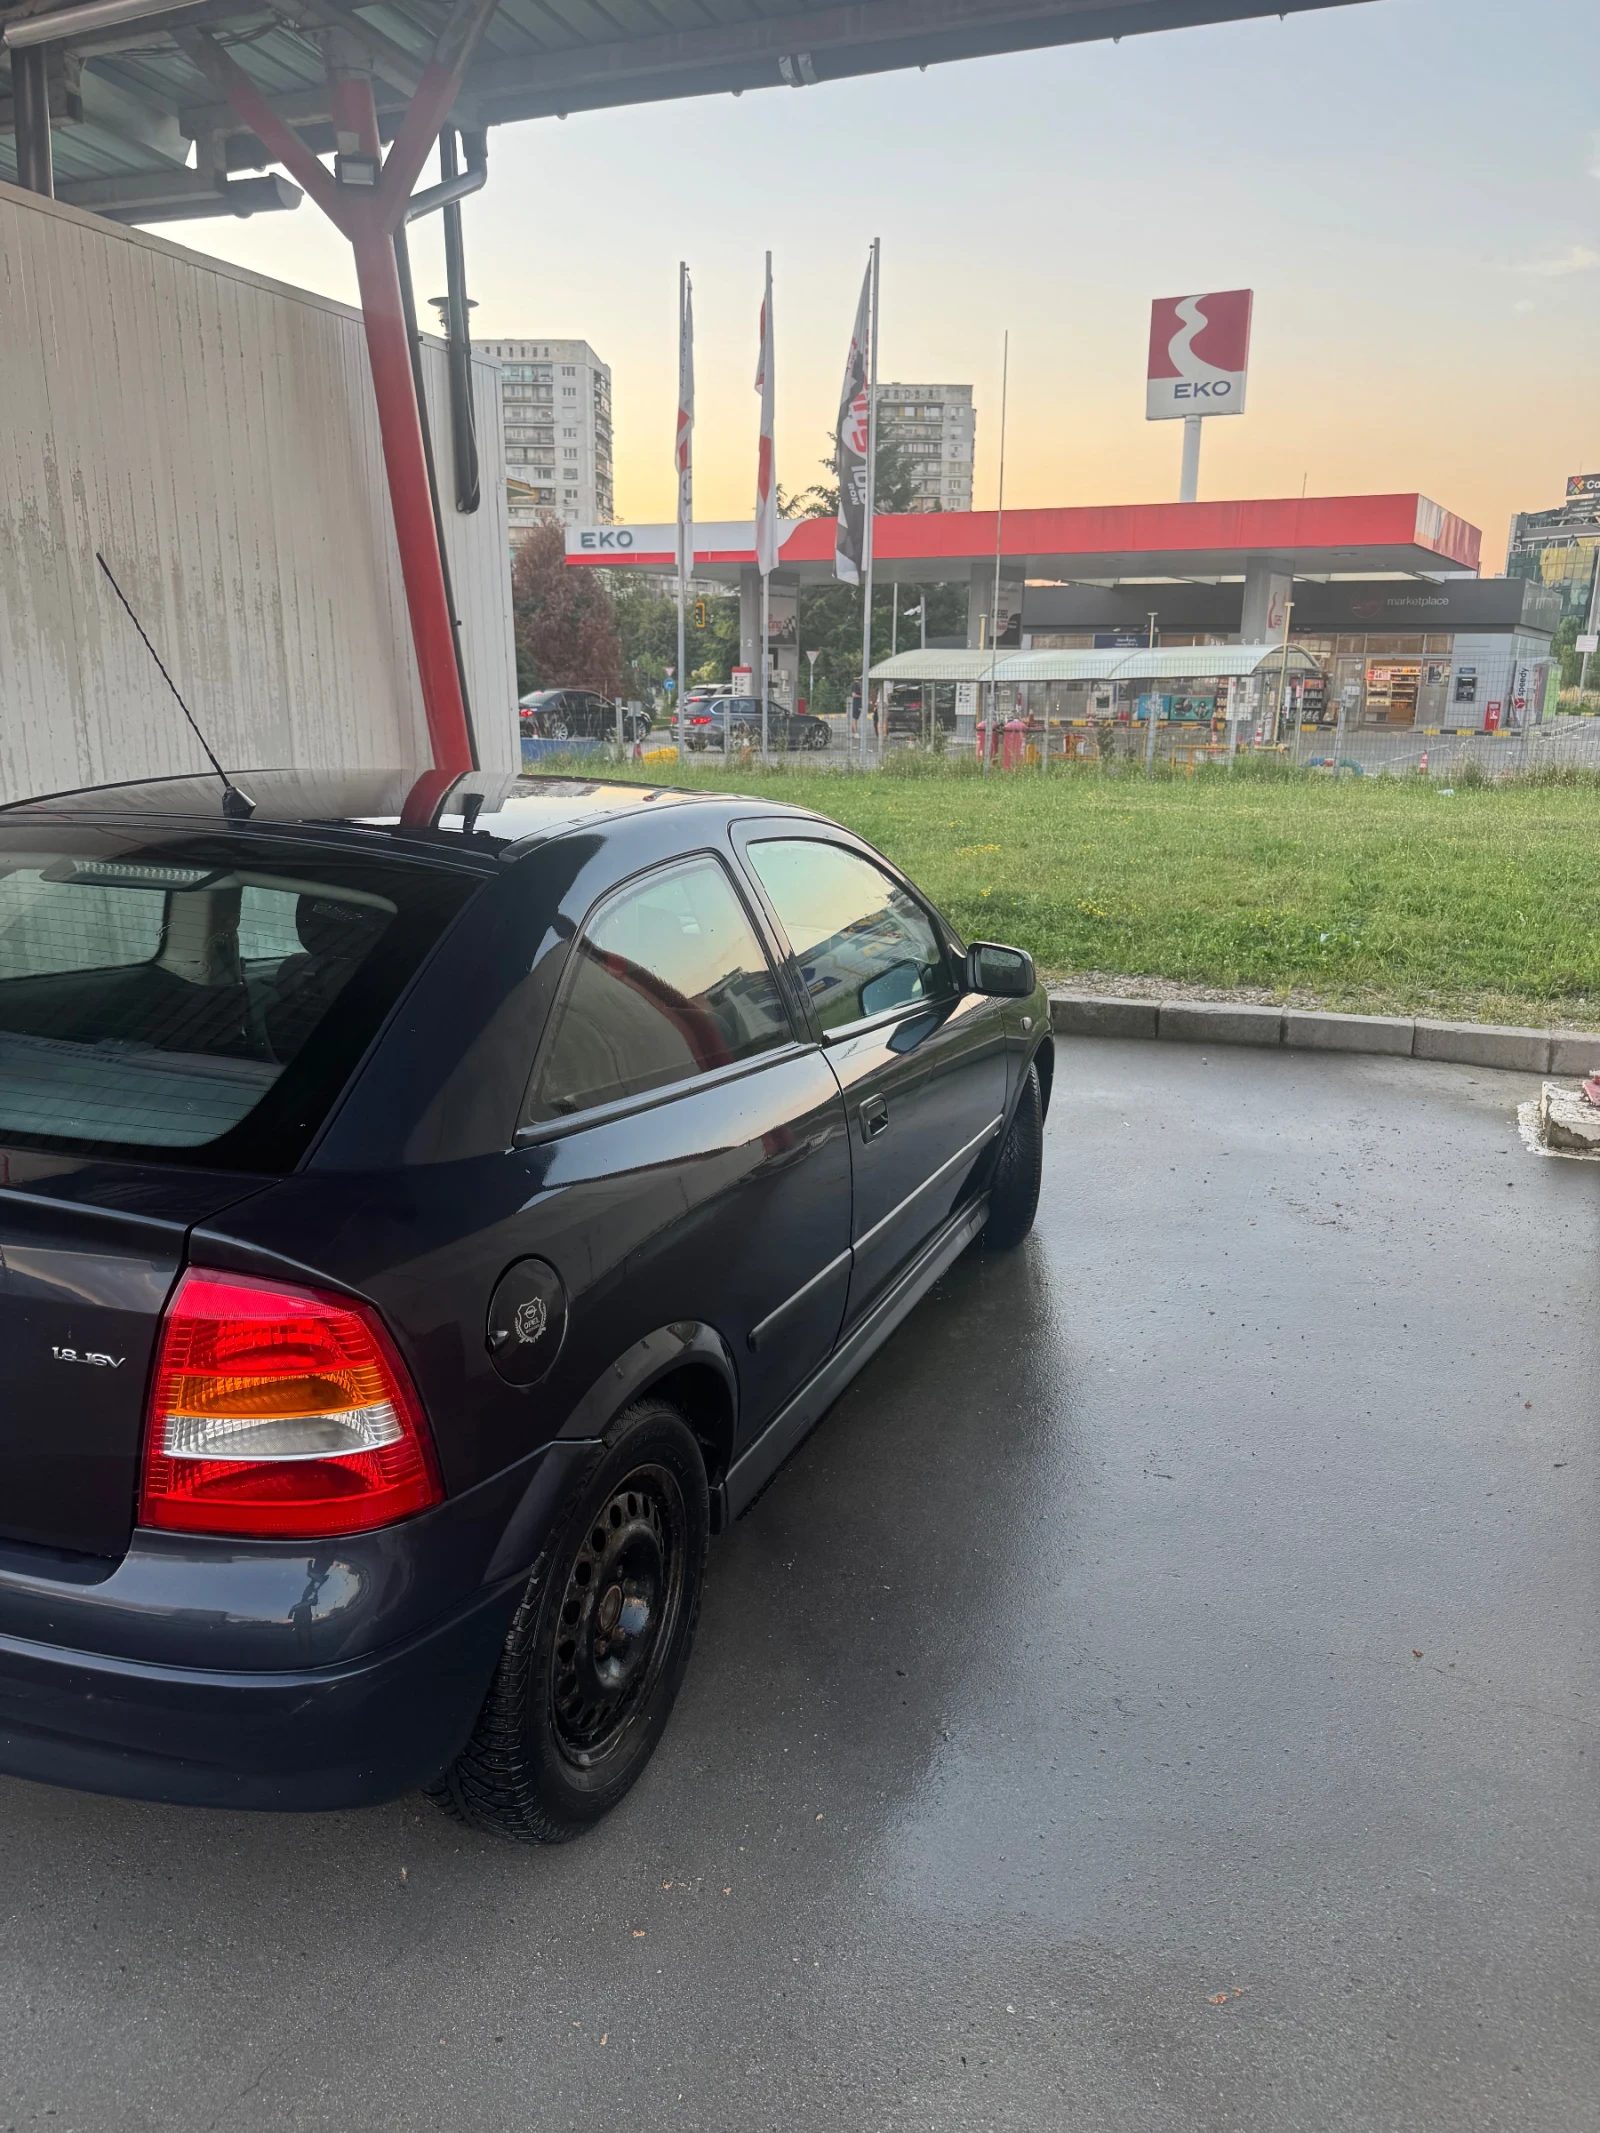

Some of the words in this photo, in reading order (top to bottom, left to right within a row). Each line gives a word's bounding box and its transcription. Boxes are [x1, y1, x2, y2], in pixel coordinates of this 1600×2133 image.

[1174, 380, 1231, 399] EKO
[847, 483, 860, 505] RON
[581, 530, 633, 548] EKO
[1387, 596, 1449, 607] marketplace
[747, 639, 753, 647] 2
[1518, 668, 1529, 696] speedy
[524, 1317, 540, 1329] OPEL
